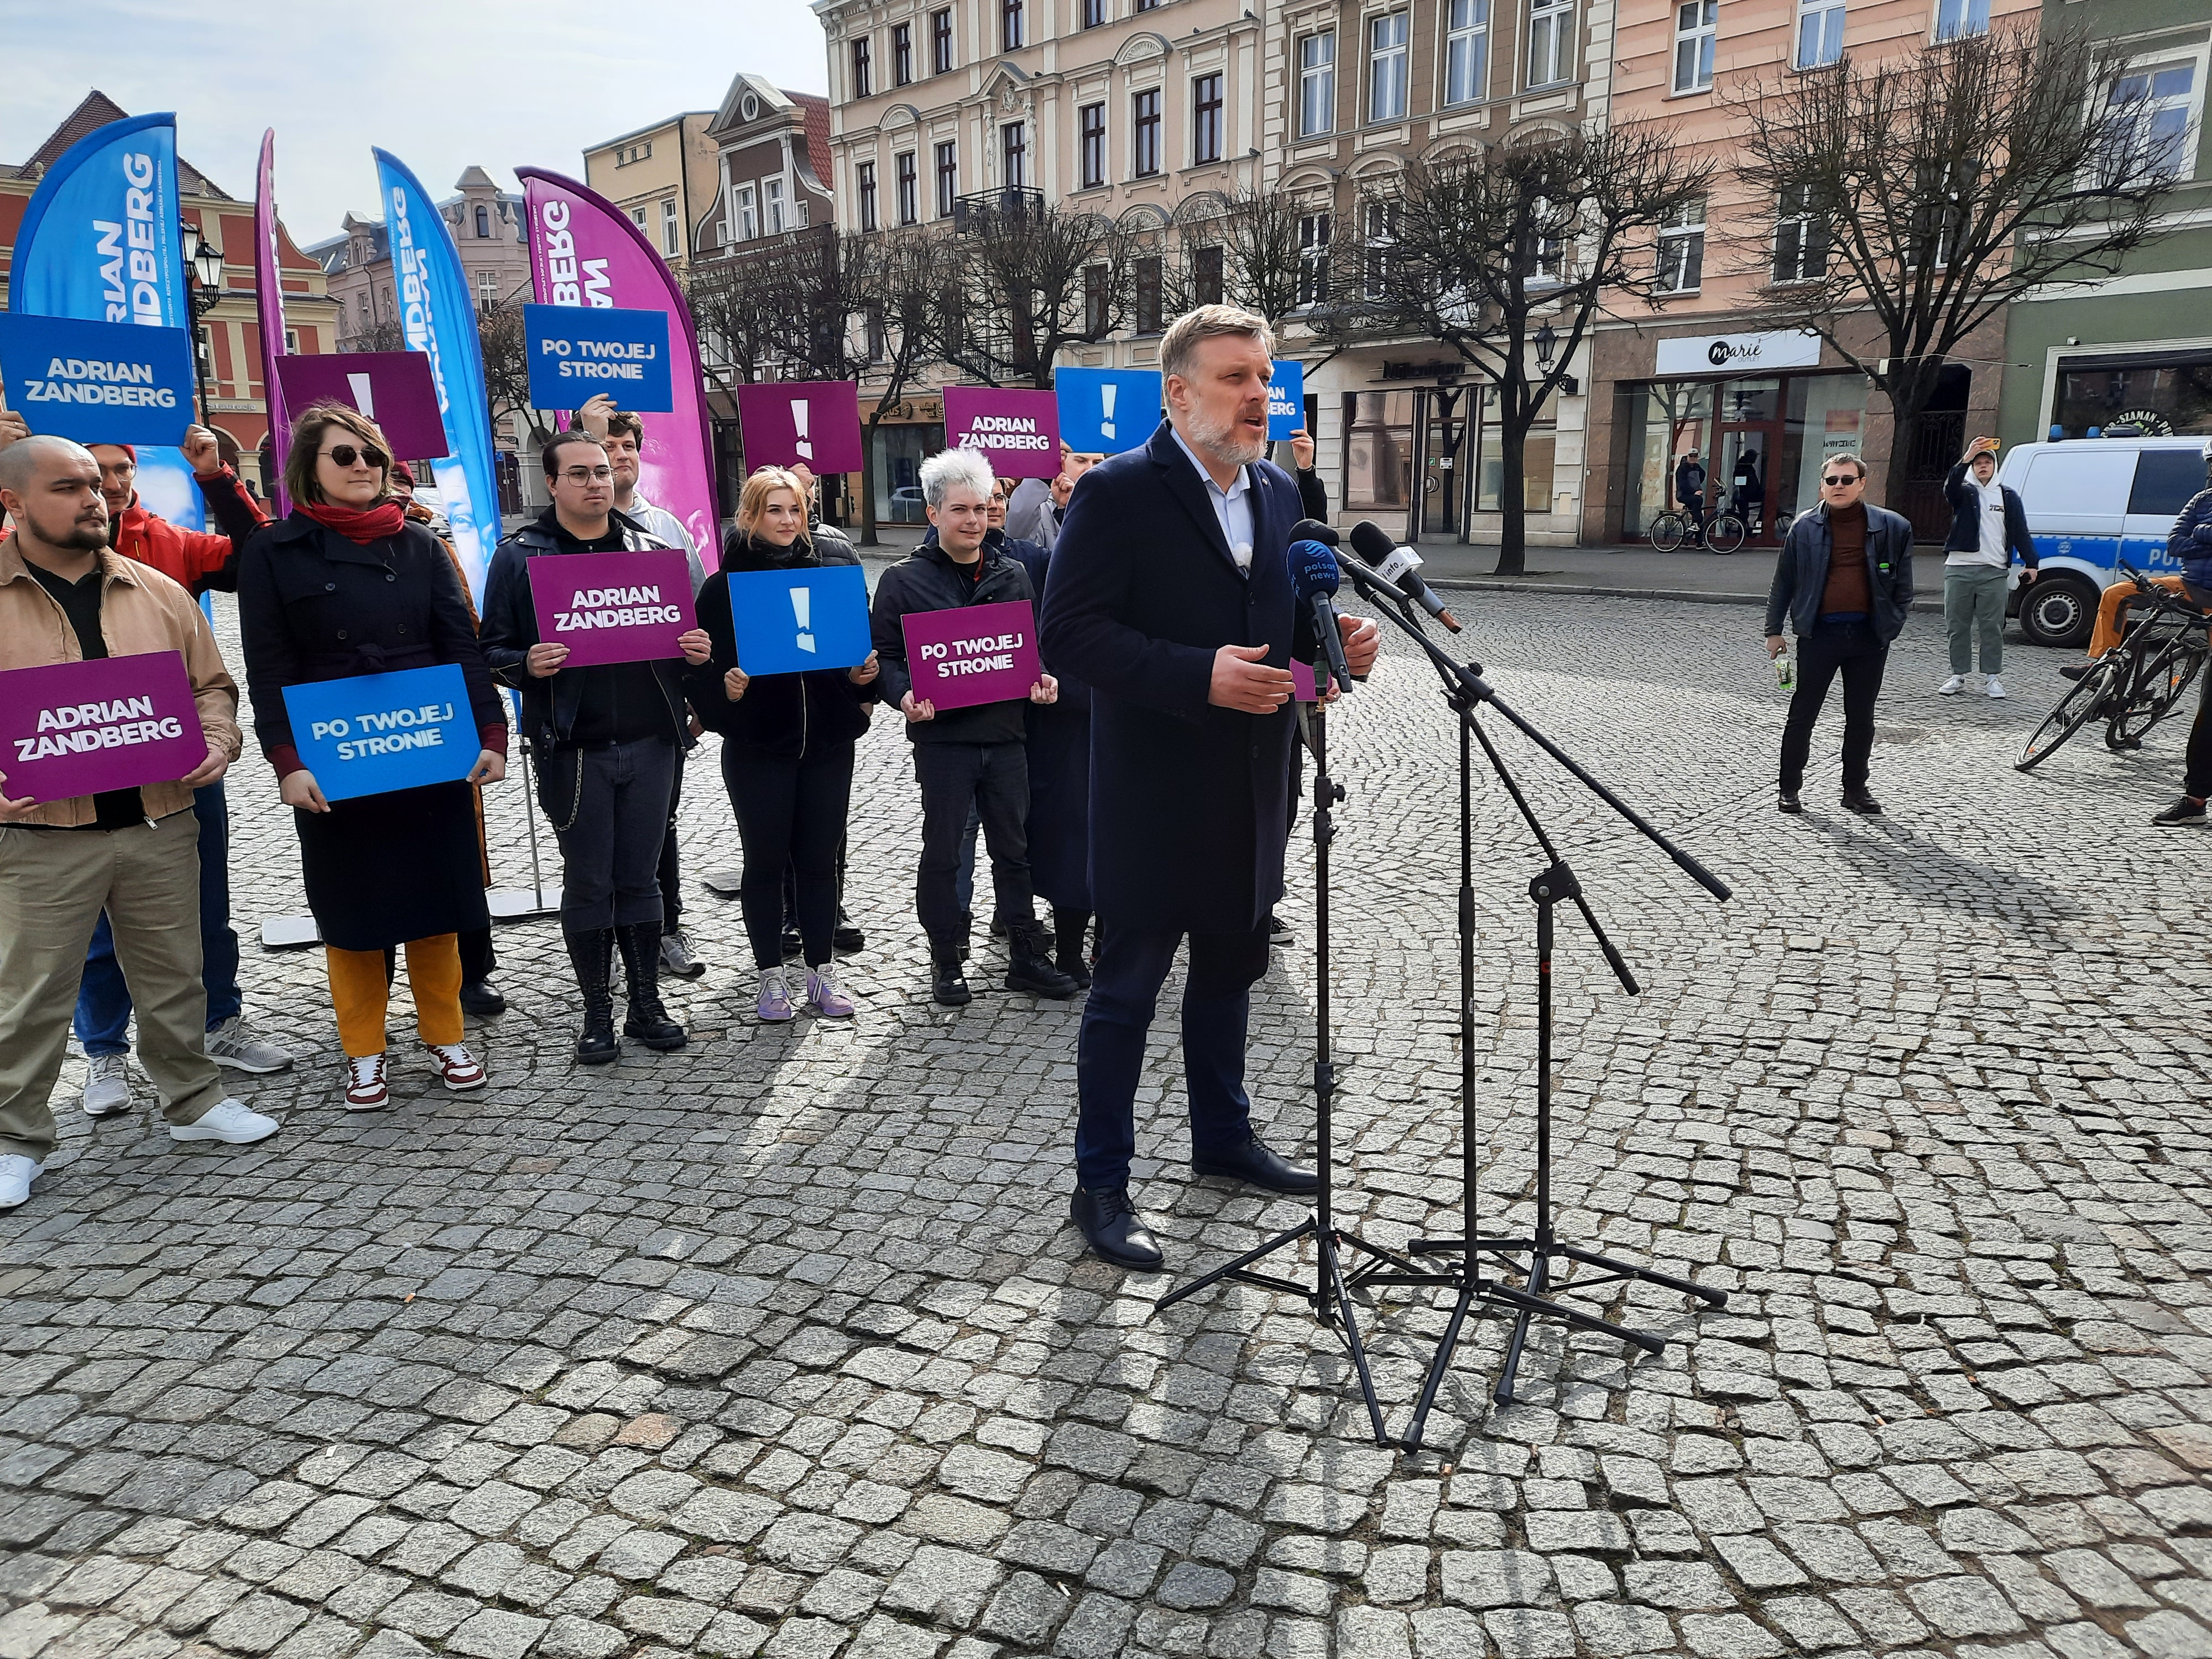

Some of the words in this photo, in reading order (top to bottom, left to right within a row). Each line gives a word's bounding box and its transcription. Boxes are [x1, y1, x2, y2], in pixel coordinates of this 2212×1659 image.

[542, 339, 571, 356] PO
[577, 341, 656, 359] TWOJEJ
[47, 358, 153, 384] ADRIAN
[559, 361, 643, 379] STRONIE
[25, 380, 176, 408] ZANDBERG
[972, 416, 1036, 432] ADRIAN
[2119, 410, 2158, 423] SZAMAN
[958, 433, 1050, 450] ZANDBERG
[1304, 562, 1337, 574] polsat
[1310, 572, 1335, 581] news
[571, 586, 660, 609] ADRIAN
[554, 605, 681, 631] ZANDBERG
[921, 643, 947, 660] PO
[952, 633, 1023, 655] TWOJEJ
[937, 654, 1014, 677] STRONIE
[37, 695, 154, 732] ADRIAN
[311, 719, 349, 740] PO
[356, 702, 454, 733] TWOJEJ
[14, 717, 182, 761] ZANDBERG
[337, 728, 443, 760] STRONIE
